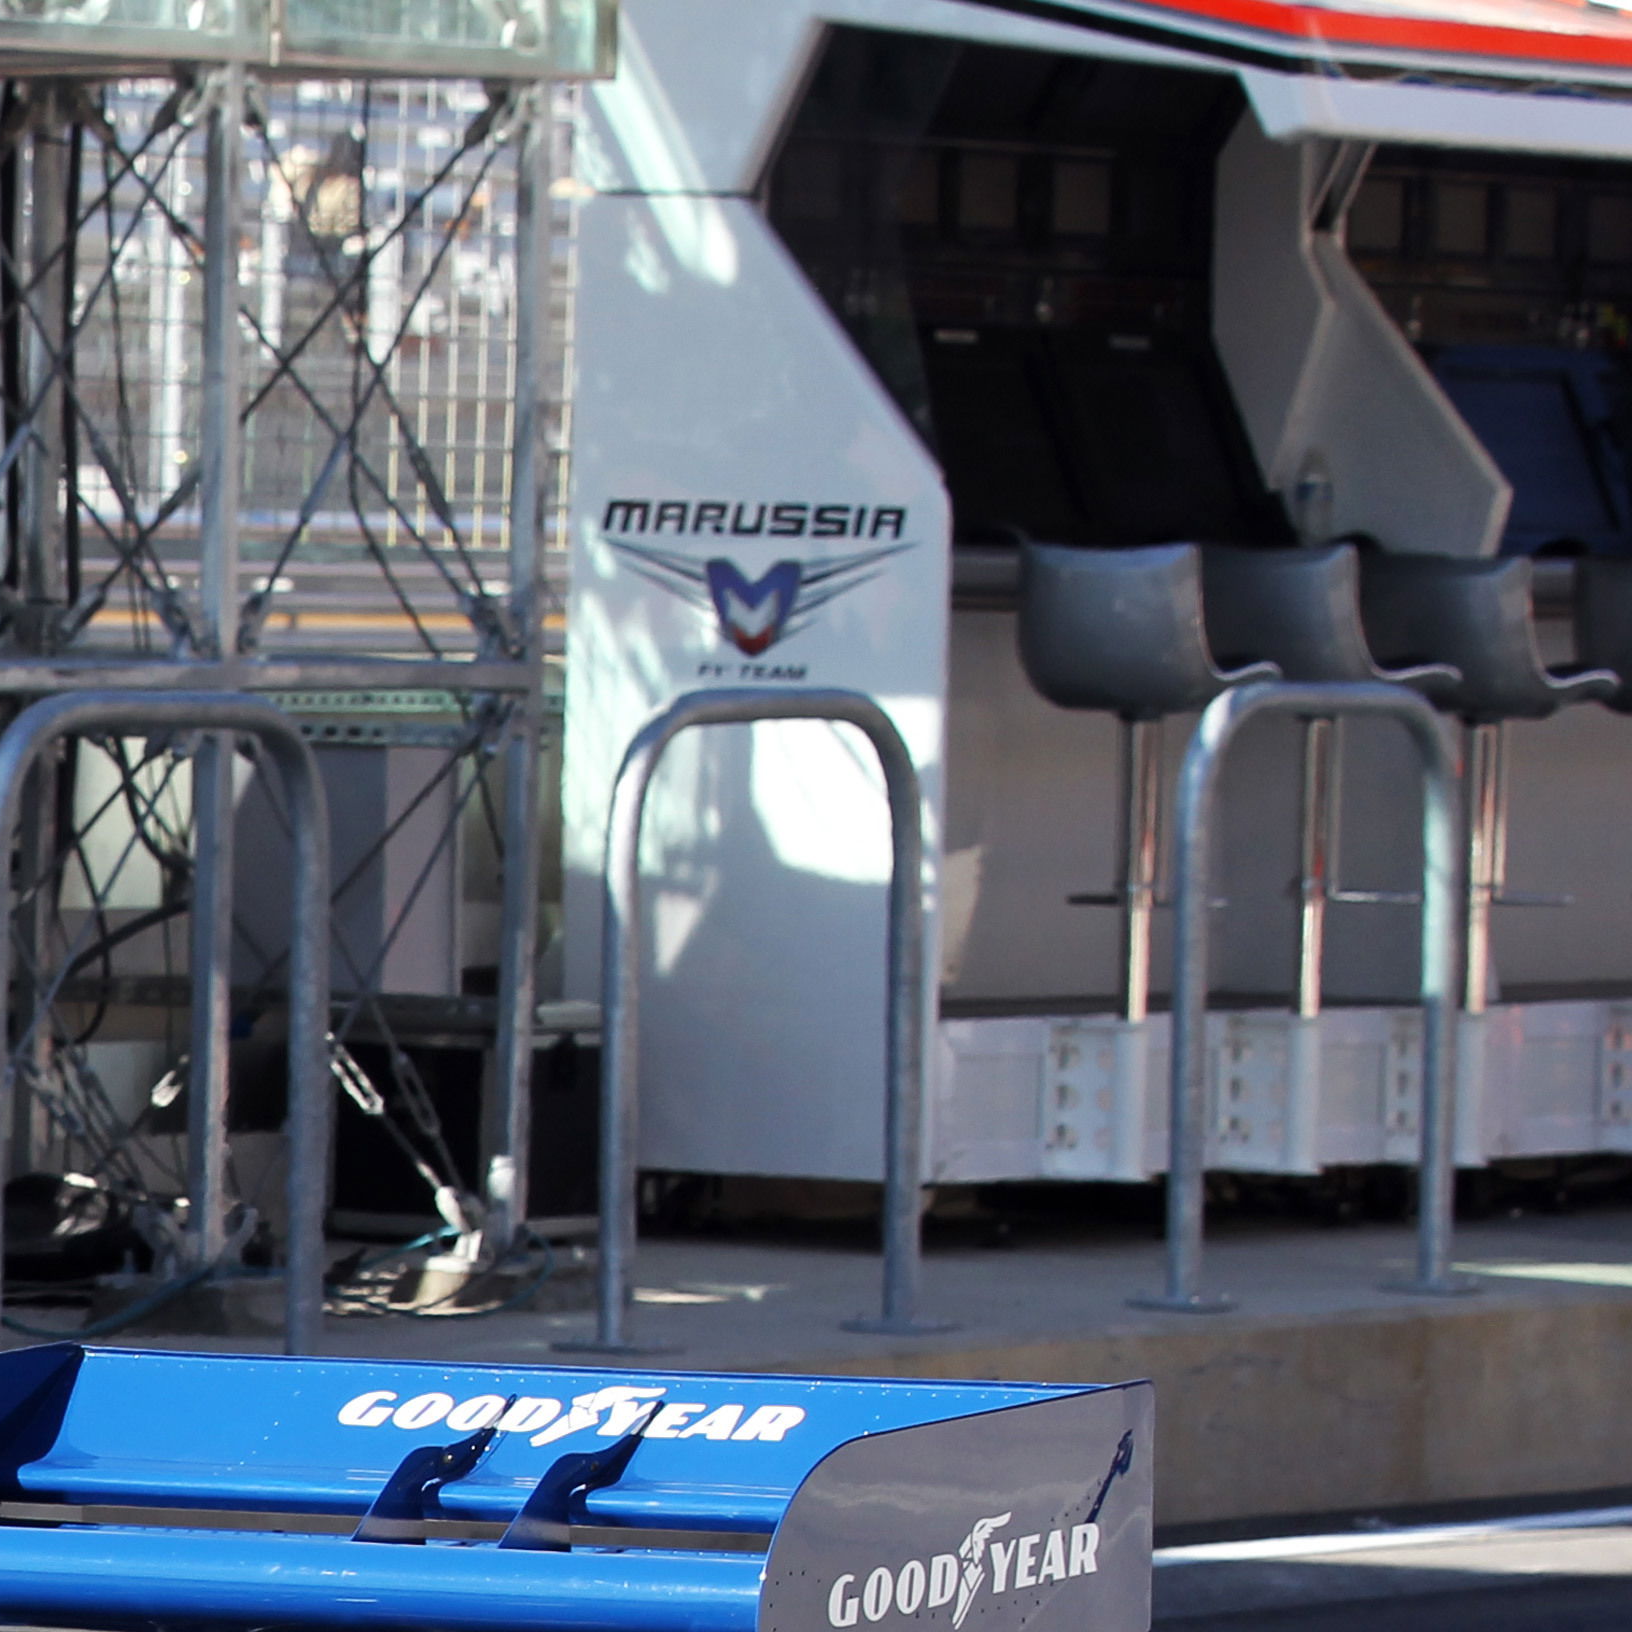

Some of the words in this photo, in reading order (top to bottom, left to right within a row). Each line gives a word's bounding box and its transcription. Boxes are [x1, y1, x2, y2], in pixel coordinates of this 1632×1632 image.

[603, 501, 906, 539] MARUSSIA
[739, 664, 808, 680] TEAM
[338, 1387, 806, 1446] GOODYEAR
